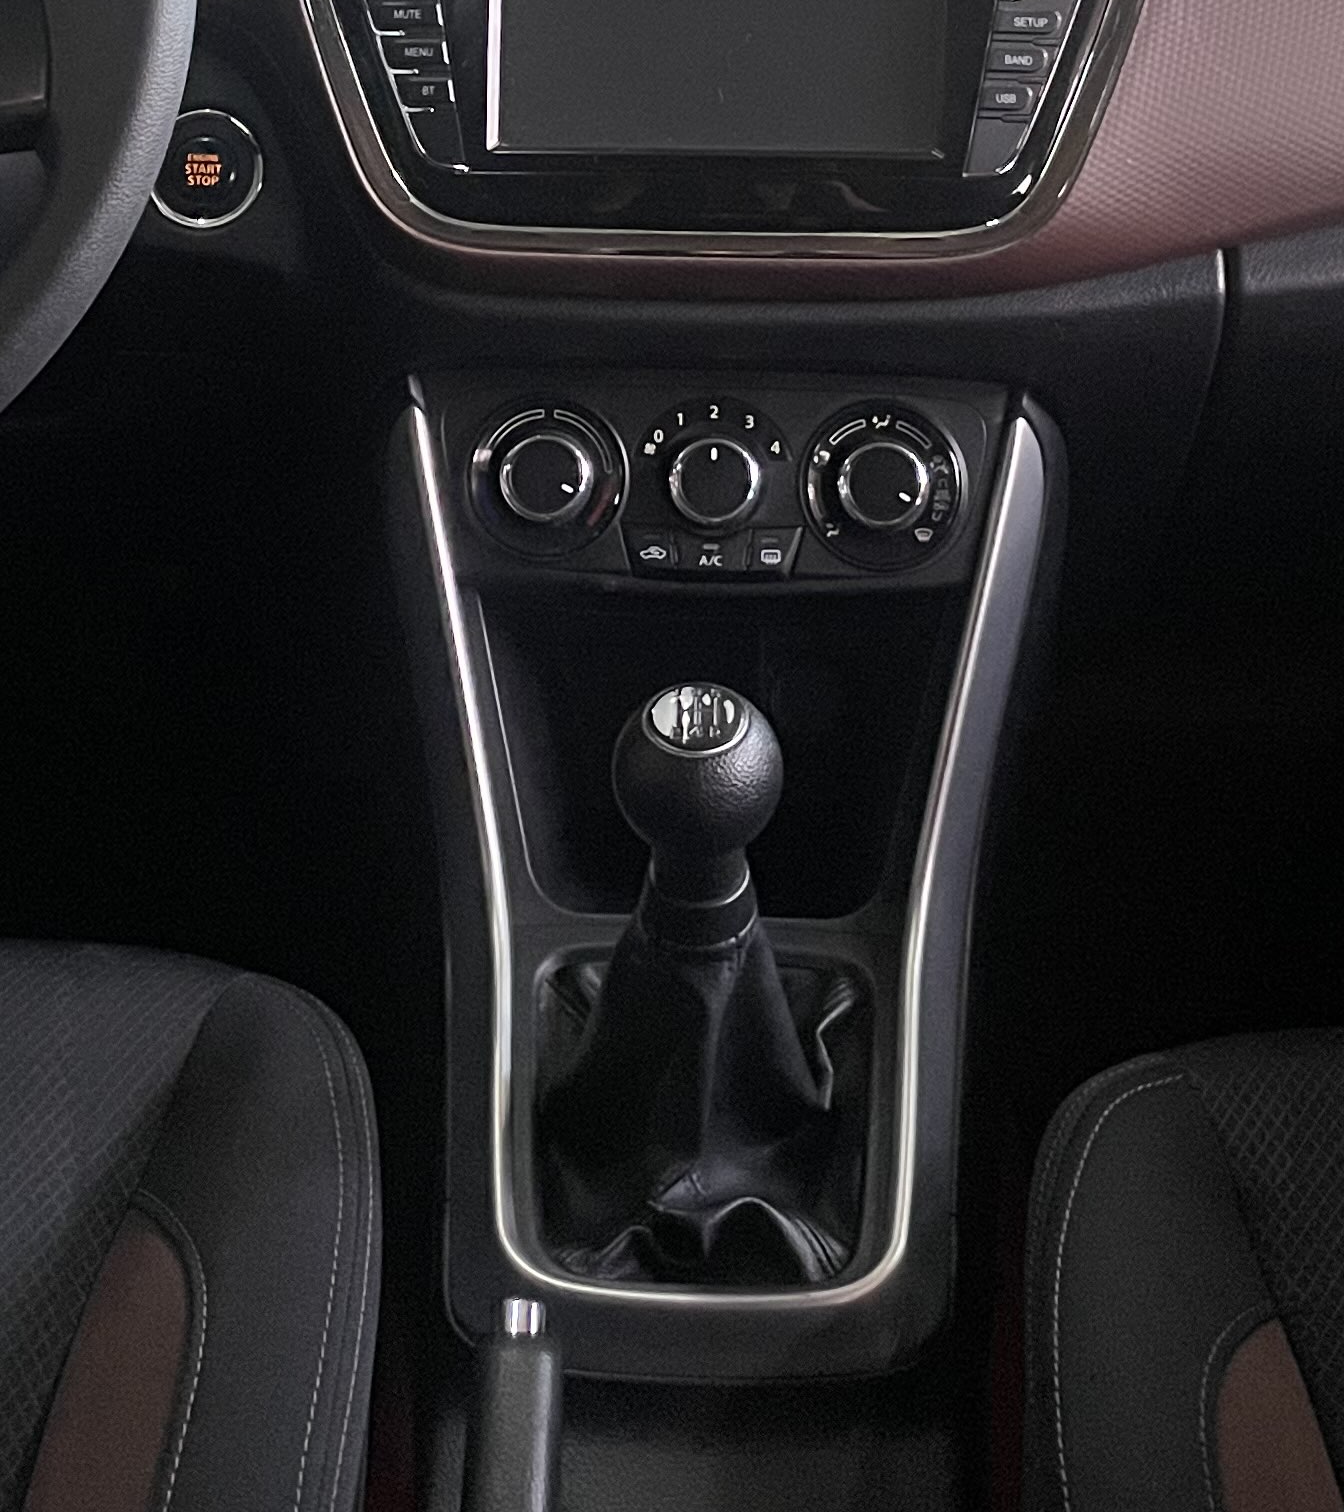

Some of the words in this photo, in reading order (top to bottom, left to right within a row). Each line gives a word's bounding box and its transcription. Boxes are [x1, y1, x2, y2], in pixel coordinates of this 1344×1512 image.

[393, 8, 422, 19] MUTE
[1013, 16, 1049, 28] SETUP
[404, 47, 434, 57] MENU
[1004, 54, 1033, 66] BAND
[421, 85, 435, 96] BT
[995, 93, 1017, 104] USB
[184, 162, 223, 175] START
[187, 174, 220, 186] STOP
[709, 405, 720, 420] 2
[676, 412, 684, 427] 1
[744, 414, 755, 430] 3
[653, 429, 664, 444] 0
[770, 440, 781, 455] 4
[698, 554, 723, 567] A/C
